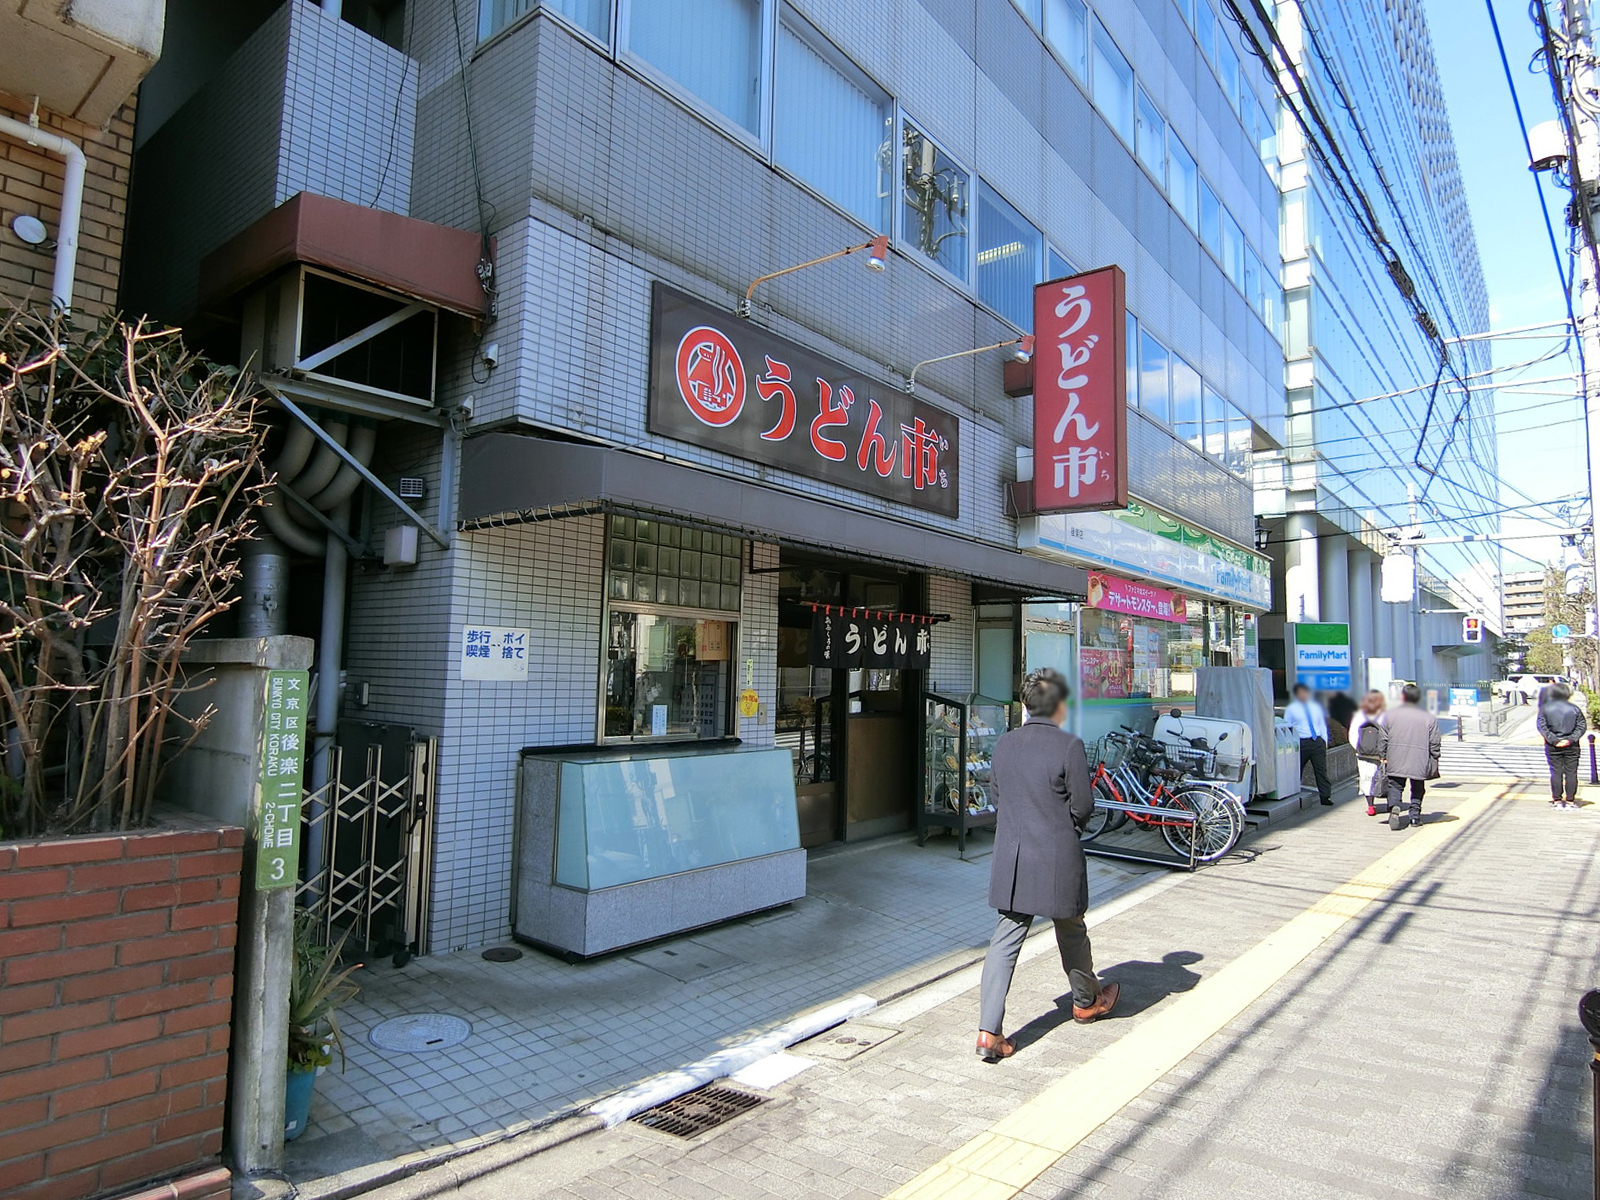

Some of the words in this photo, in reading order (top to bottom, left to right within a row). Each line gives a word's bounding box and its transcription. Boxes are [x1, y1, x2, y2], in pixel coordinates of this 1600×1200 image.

[1053, 284, 1100, 498] うどん市
[755, 354, 939, 490] うどん市
[1098, 450, 1110, 482] いち
[466, 644, 490, 658] 喫煙
[467, 630, 491, 644] 歩行
[502, 646, 525, 659] 捨て
[503, 632, 525, 645] ポイ
[845, 623, 928, 655] うどん市
[1299, 650, 1347, 661] FamilyMart
[271, 677, 283, 709] BUNKYO
[269, 712, 281, 730] CITY
[267, 733, 279, 777] KORAKU
[276, 677, 301, 848] 文京区後楽二丁目
[263, 802, 276, 849] 2-CHOME
[270, 857, 285, 881] 3
